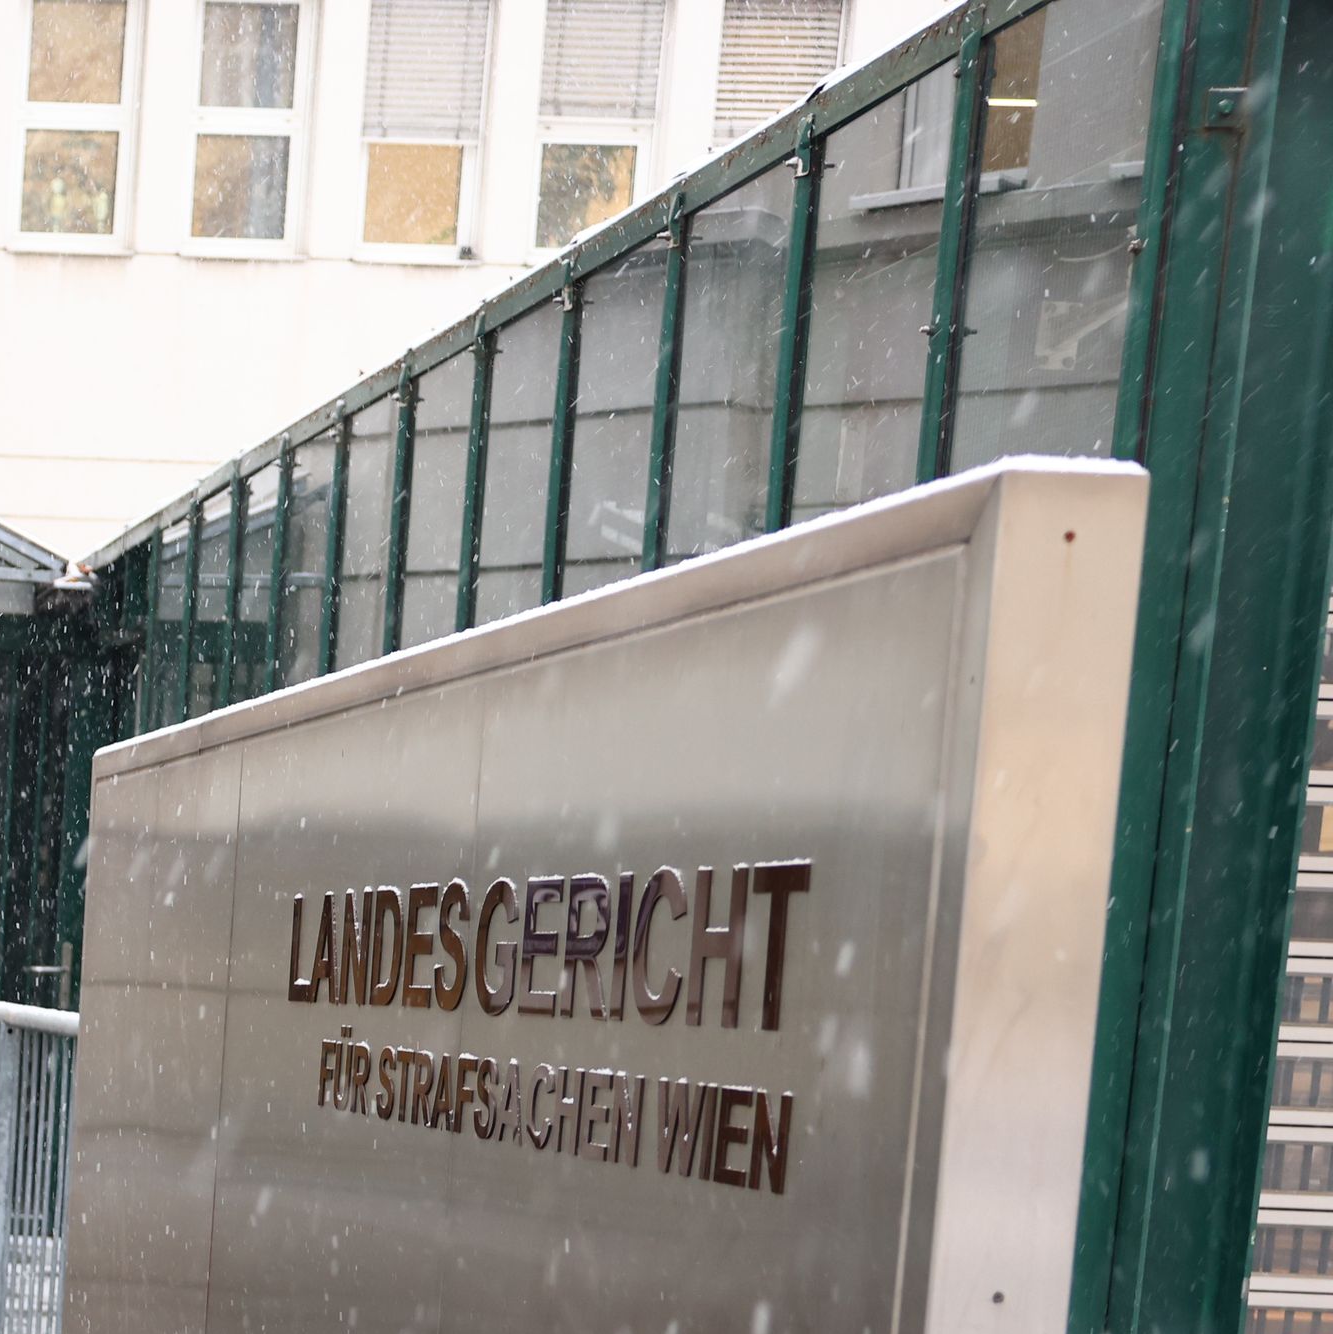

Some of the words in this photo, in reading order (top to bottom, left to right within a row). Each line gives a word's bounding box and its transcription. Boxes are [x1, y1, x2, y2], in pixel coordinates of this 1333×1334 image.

[287, 858, 813, 1031] LANDESGERICHT
[317, 1024, 373, 1115] FÜR
[375, 1045, 646, 1168] STRAFSACHEN
[655, 1075, 795, 1195] WIEN
